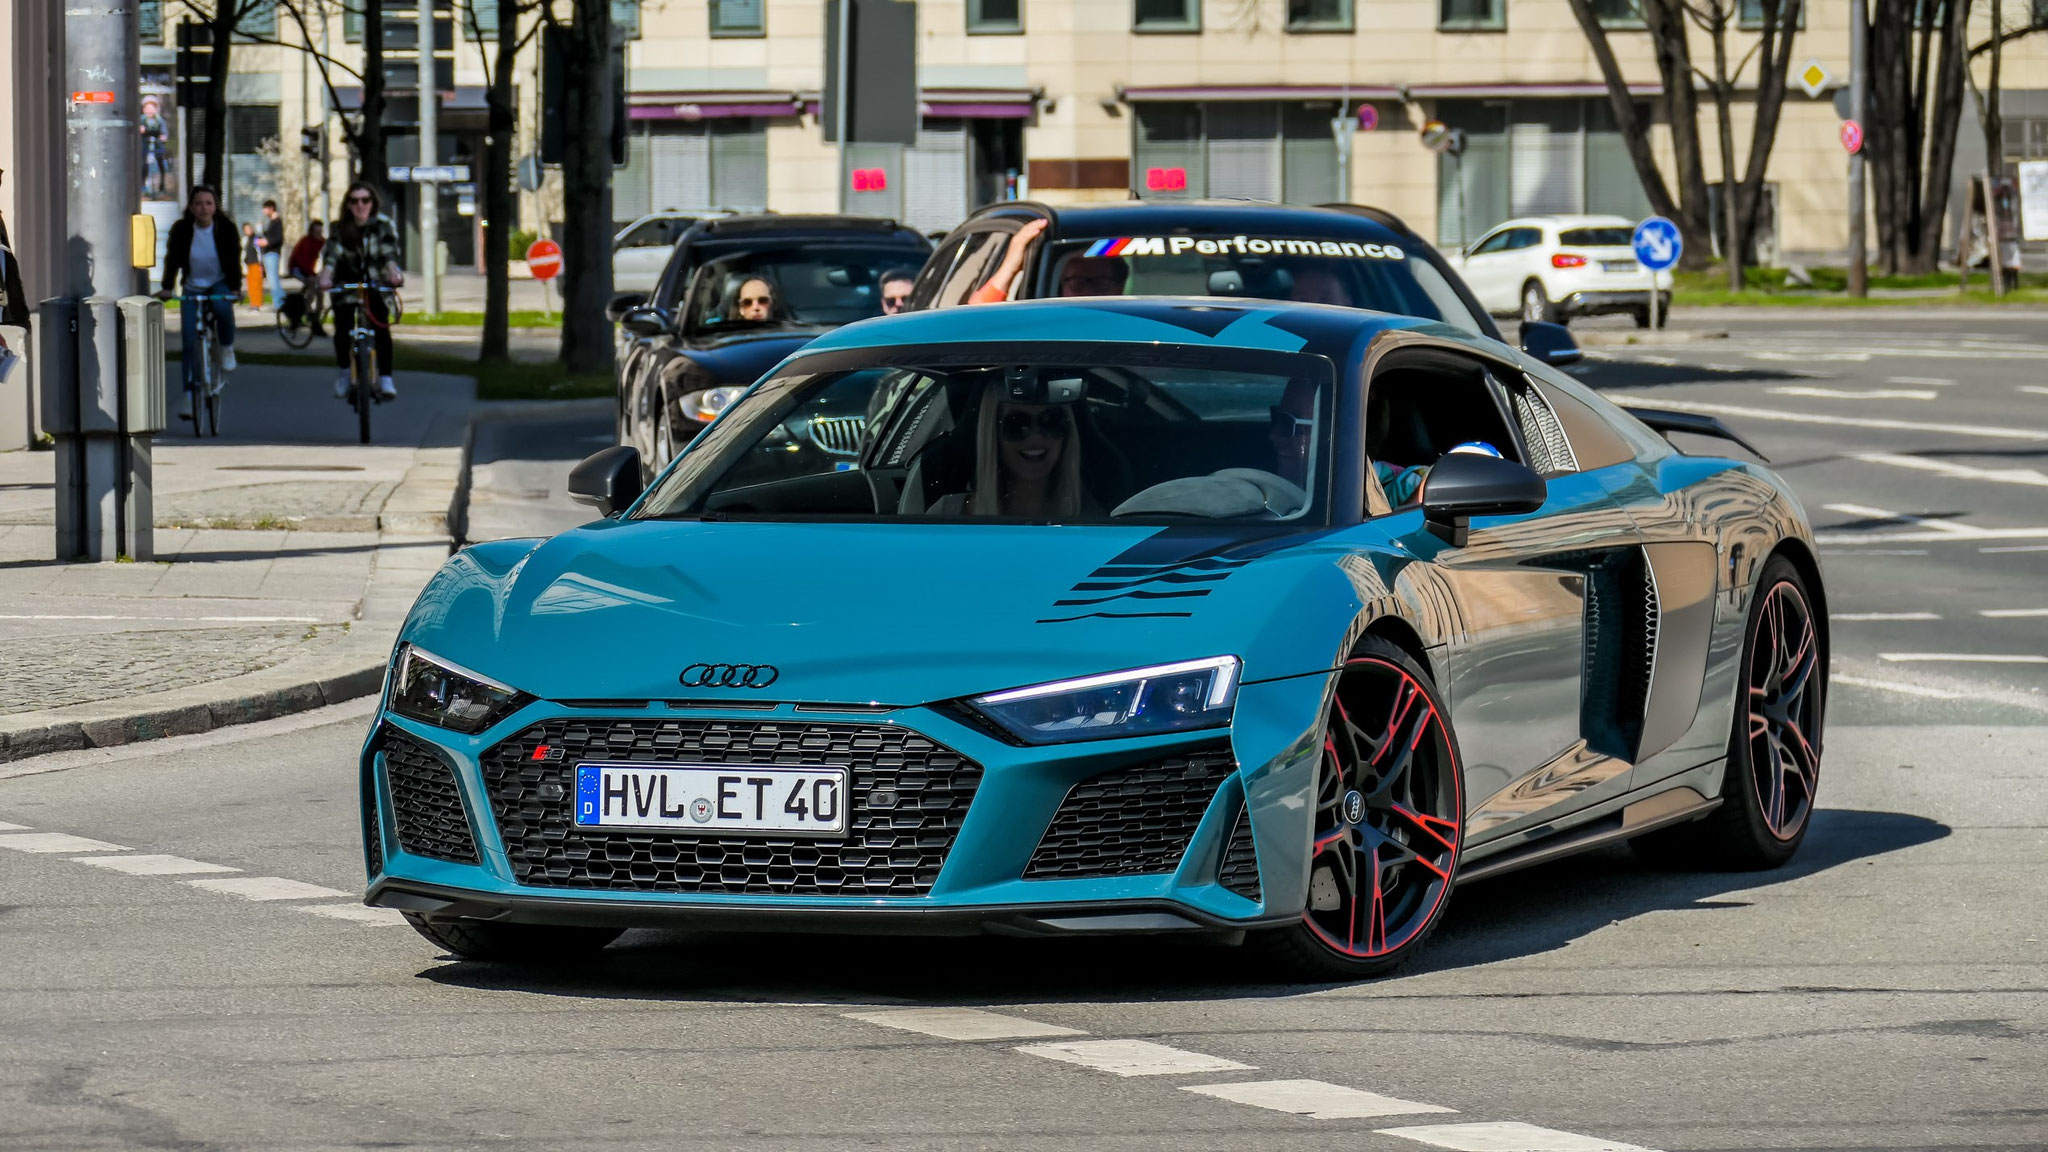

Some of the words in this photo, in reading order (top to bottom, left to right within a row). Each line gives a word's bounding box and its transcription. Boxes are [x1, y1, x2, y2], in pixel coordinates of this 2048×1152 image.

[1119, 237, 1166, 255] M
[1169, 235, 1406, 260] Performance
[583, 801, 593, 815] D
[603, 774, 684, 818] HVL
[717, 776, 773, 821] ET
[784, 778, 838, 822] 40
